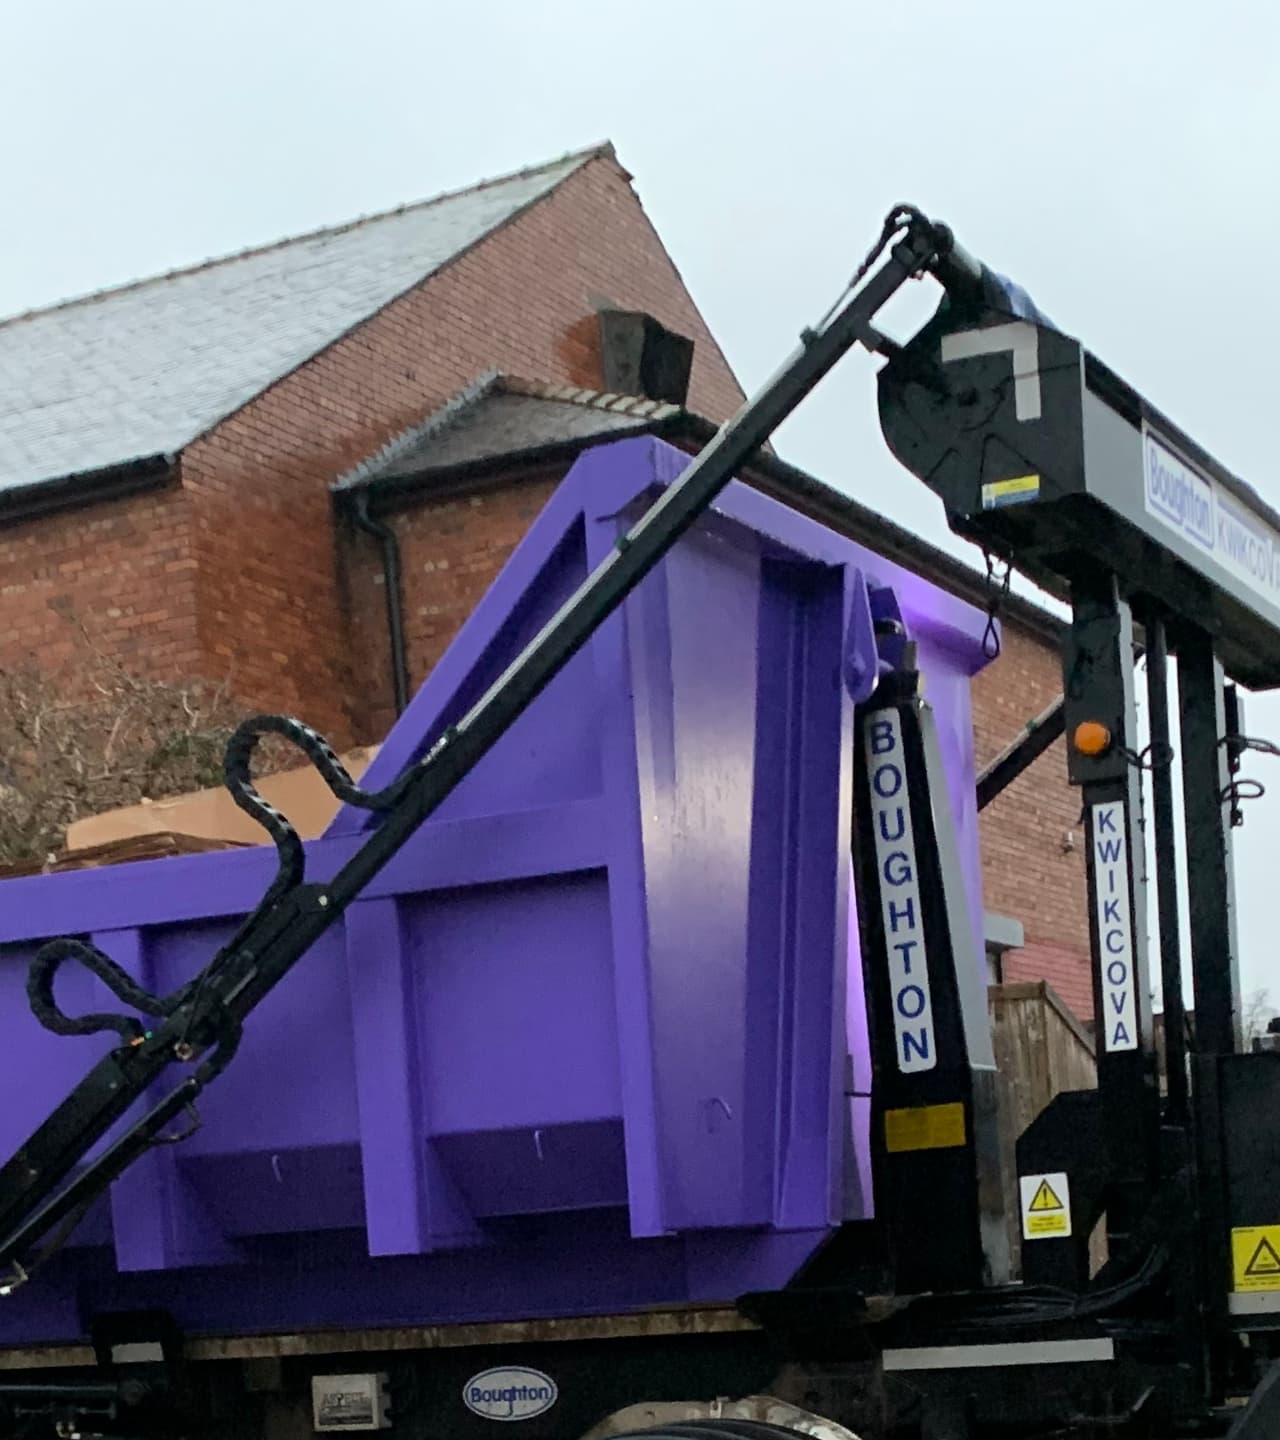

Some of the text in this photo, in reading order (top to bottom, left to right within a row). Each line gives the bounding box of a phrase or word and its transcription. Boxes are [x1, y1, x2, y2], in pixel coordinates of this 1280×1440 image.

[1150, 446, 1210, 530] Boughton
[870, 719, 931, 1064] BOUGHTON
[1096, 809, 1130, 1046] KWIKCOVA
[470, 1384, 550, 1414] Boughton
